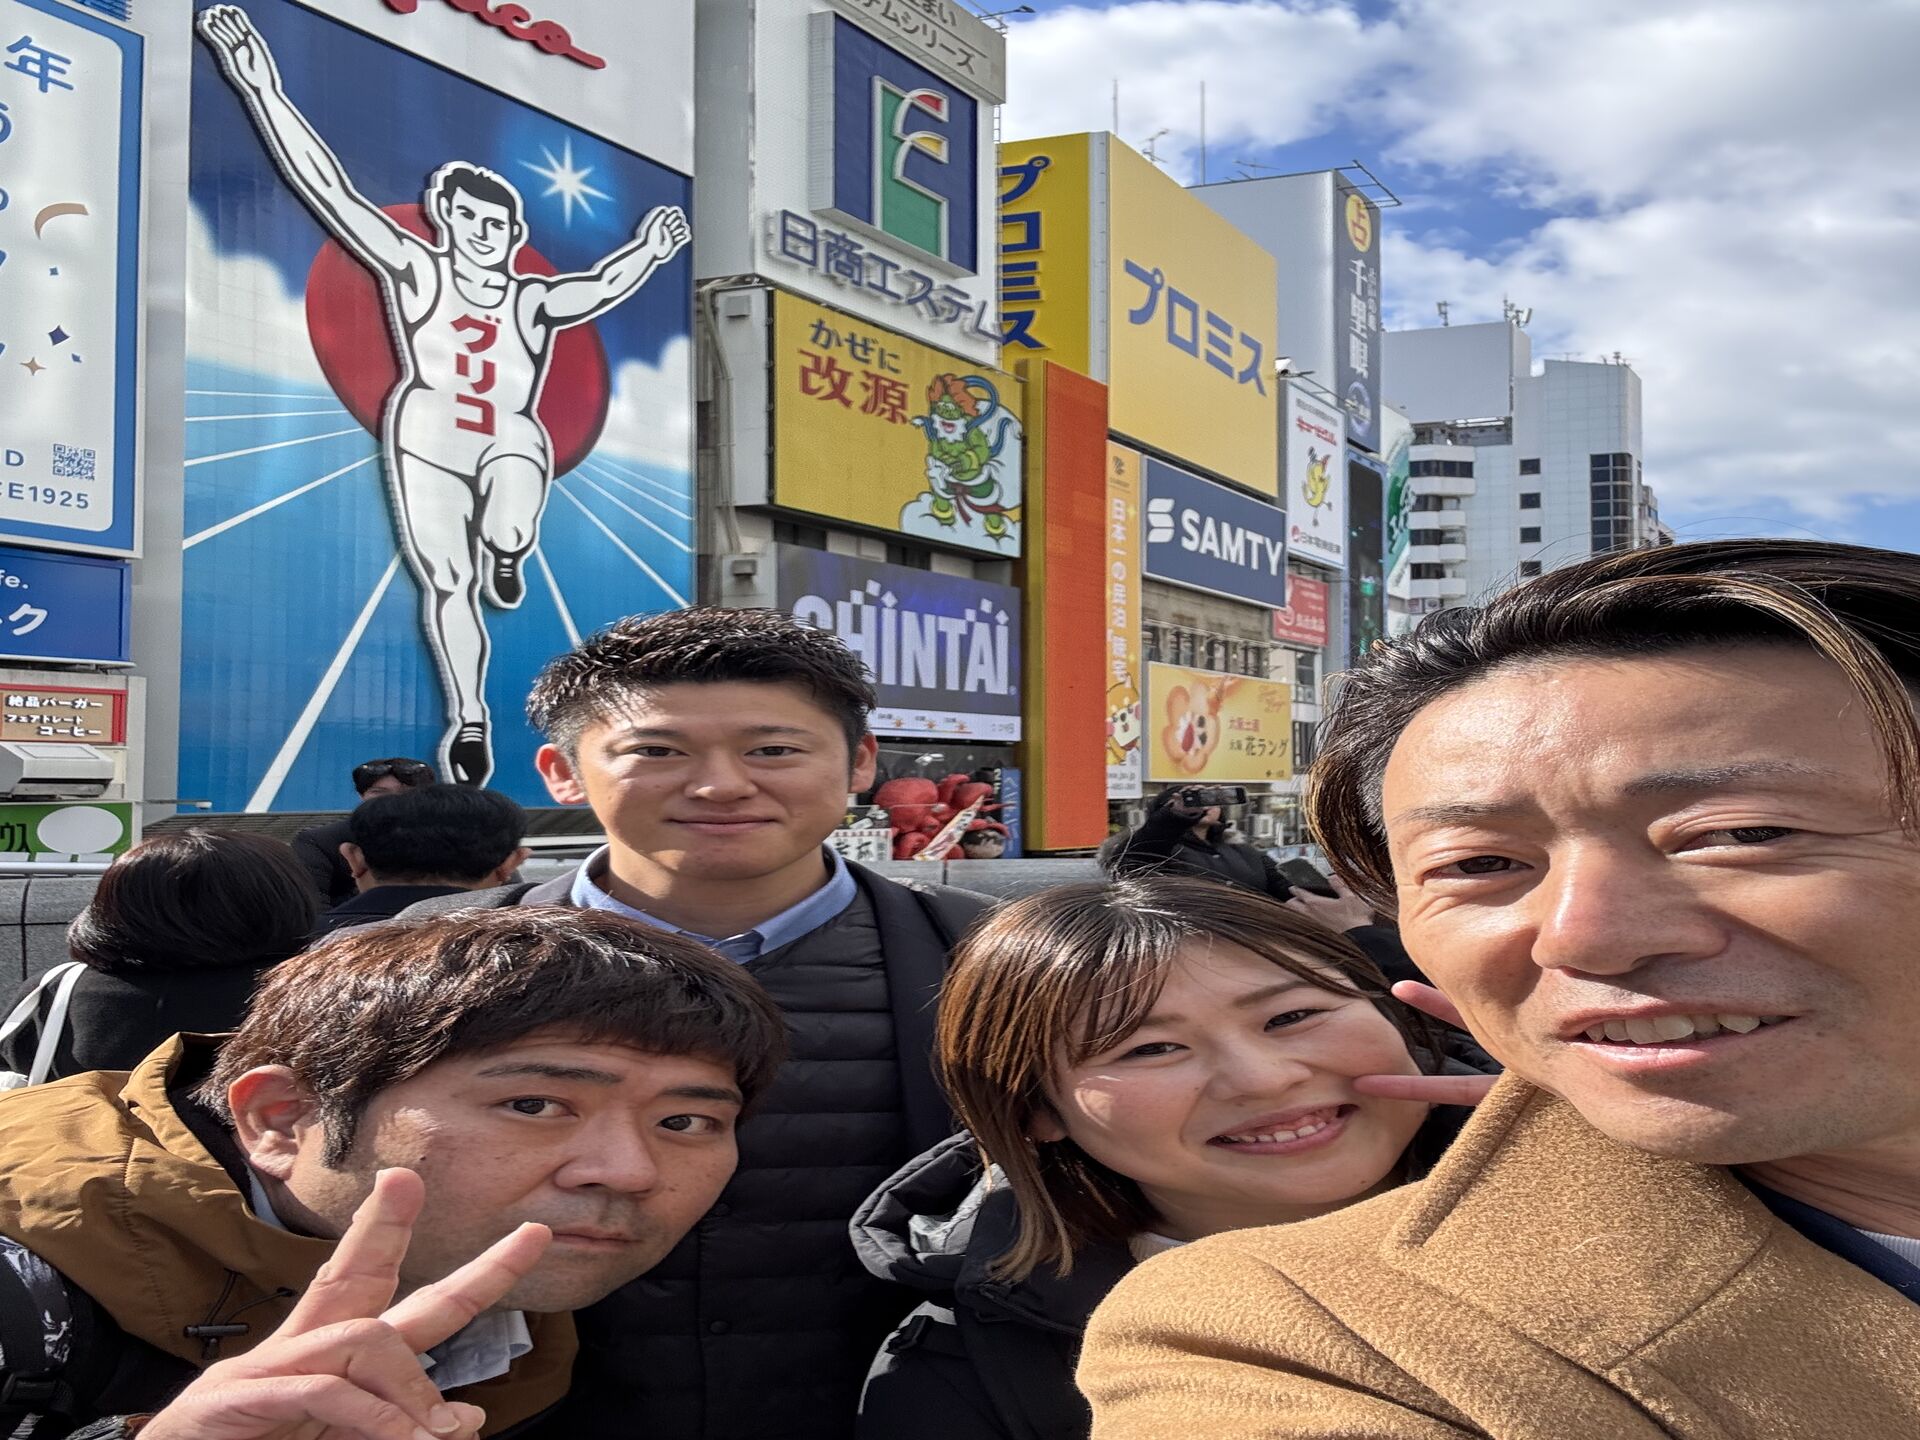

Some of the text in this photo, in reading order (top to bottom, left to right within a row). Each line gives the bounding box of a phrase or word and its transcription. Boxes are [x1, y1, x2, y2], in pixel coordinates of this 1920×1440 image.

[4, 36, 74, 93] 年
[810, 318, 902, 374] かぜに
[1123, 258, 1267, 397] プロミス
[450, 313, 502, 436] グリコ
[797, 348, 909, 426] 改源
[5, 450, 25, 468] D
[0, 481, 90, 510] E1925
[1181, 508, 1284, 577] SAMTY
[8, 603, 48, 636] ク
[37, 726, 102, 737] コーヒー
